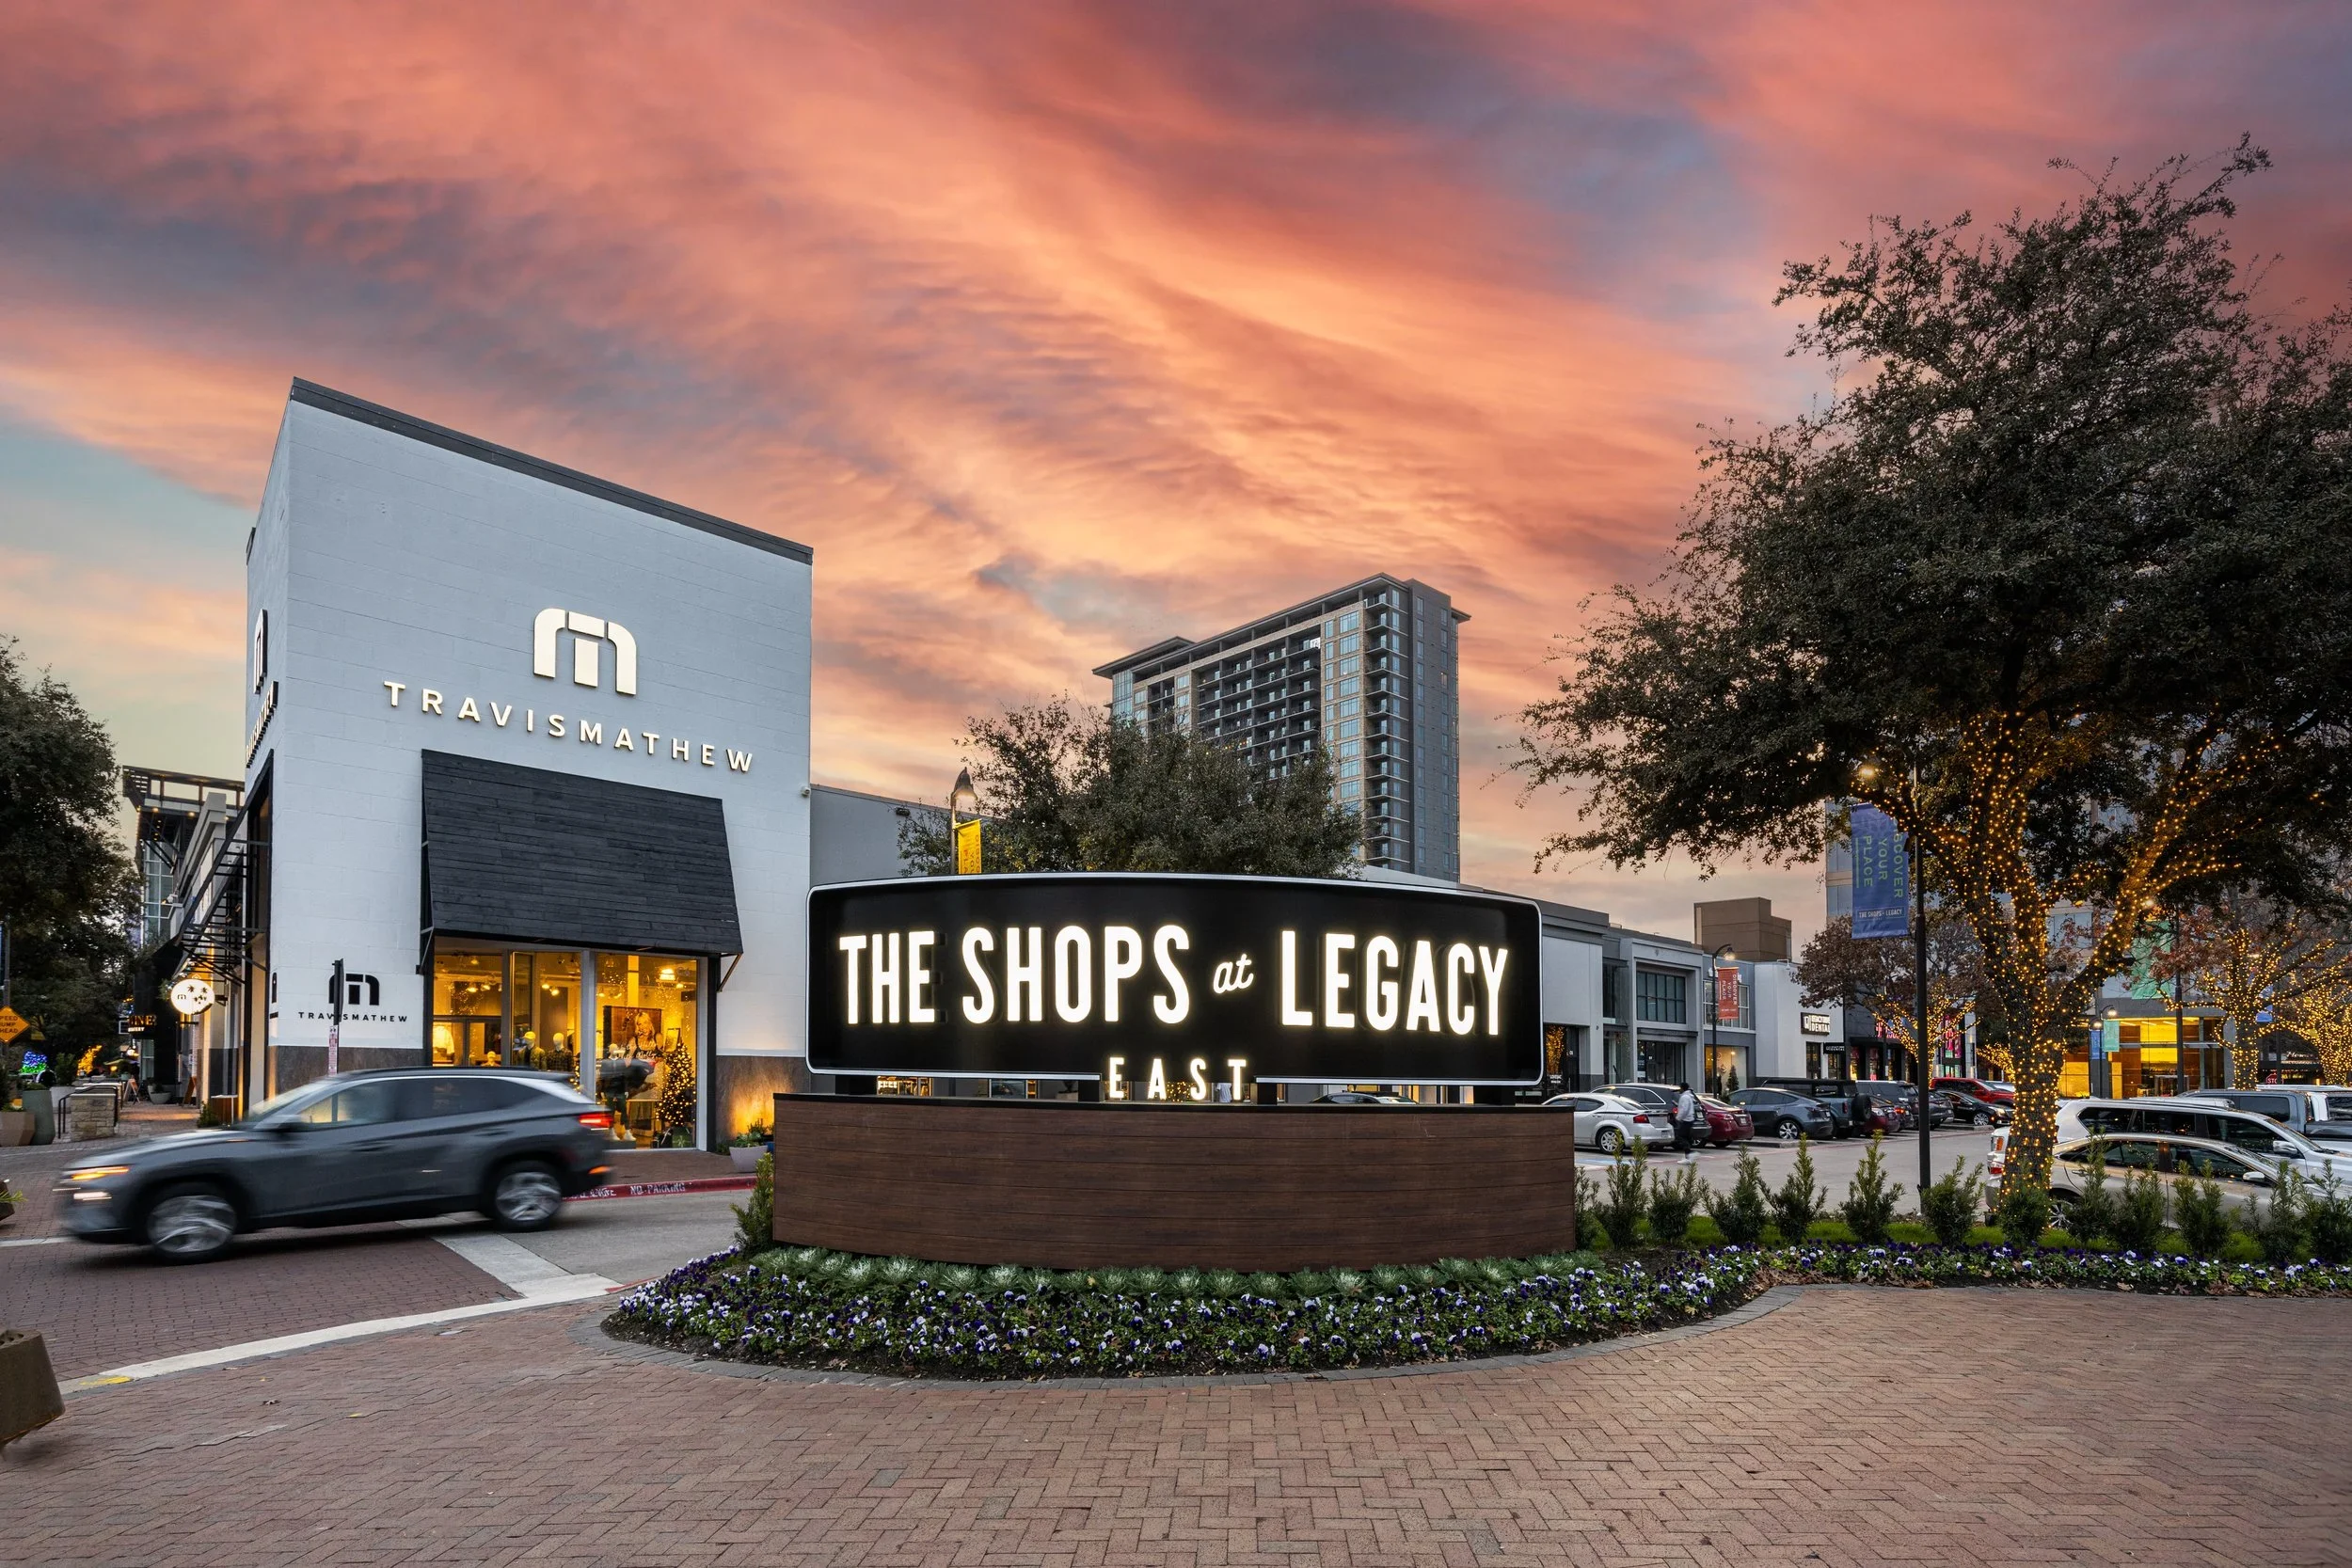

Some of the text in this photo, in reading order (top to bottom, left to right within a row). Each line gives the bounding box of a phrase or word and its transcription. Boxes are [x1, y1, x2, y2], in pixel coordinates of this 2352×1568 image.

[383, 680, 755, 774] TRAVISMATHEW
[1864, 835, 1873, 887] PLACE
[1879, 837, 1888, 880] YOUR
[837, 924, 1509, 1037] THE SHOPS at LEGACY
[298, 1011, 408, 1022] TRAVSMATHEW
[1107, 1055, 1248, 1101] EAST
[646, 1182, 686, 1195] PARKING
